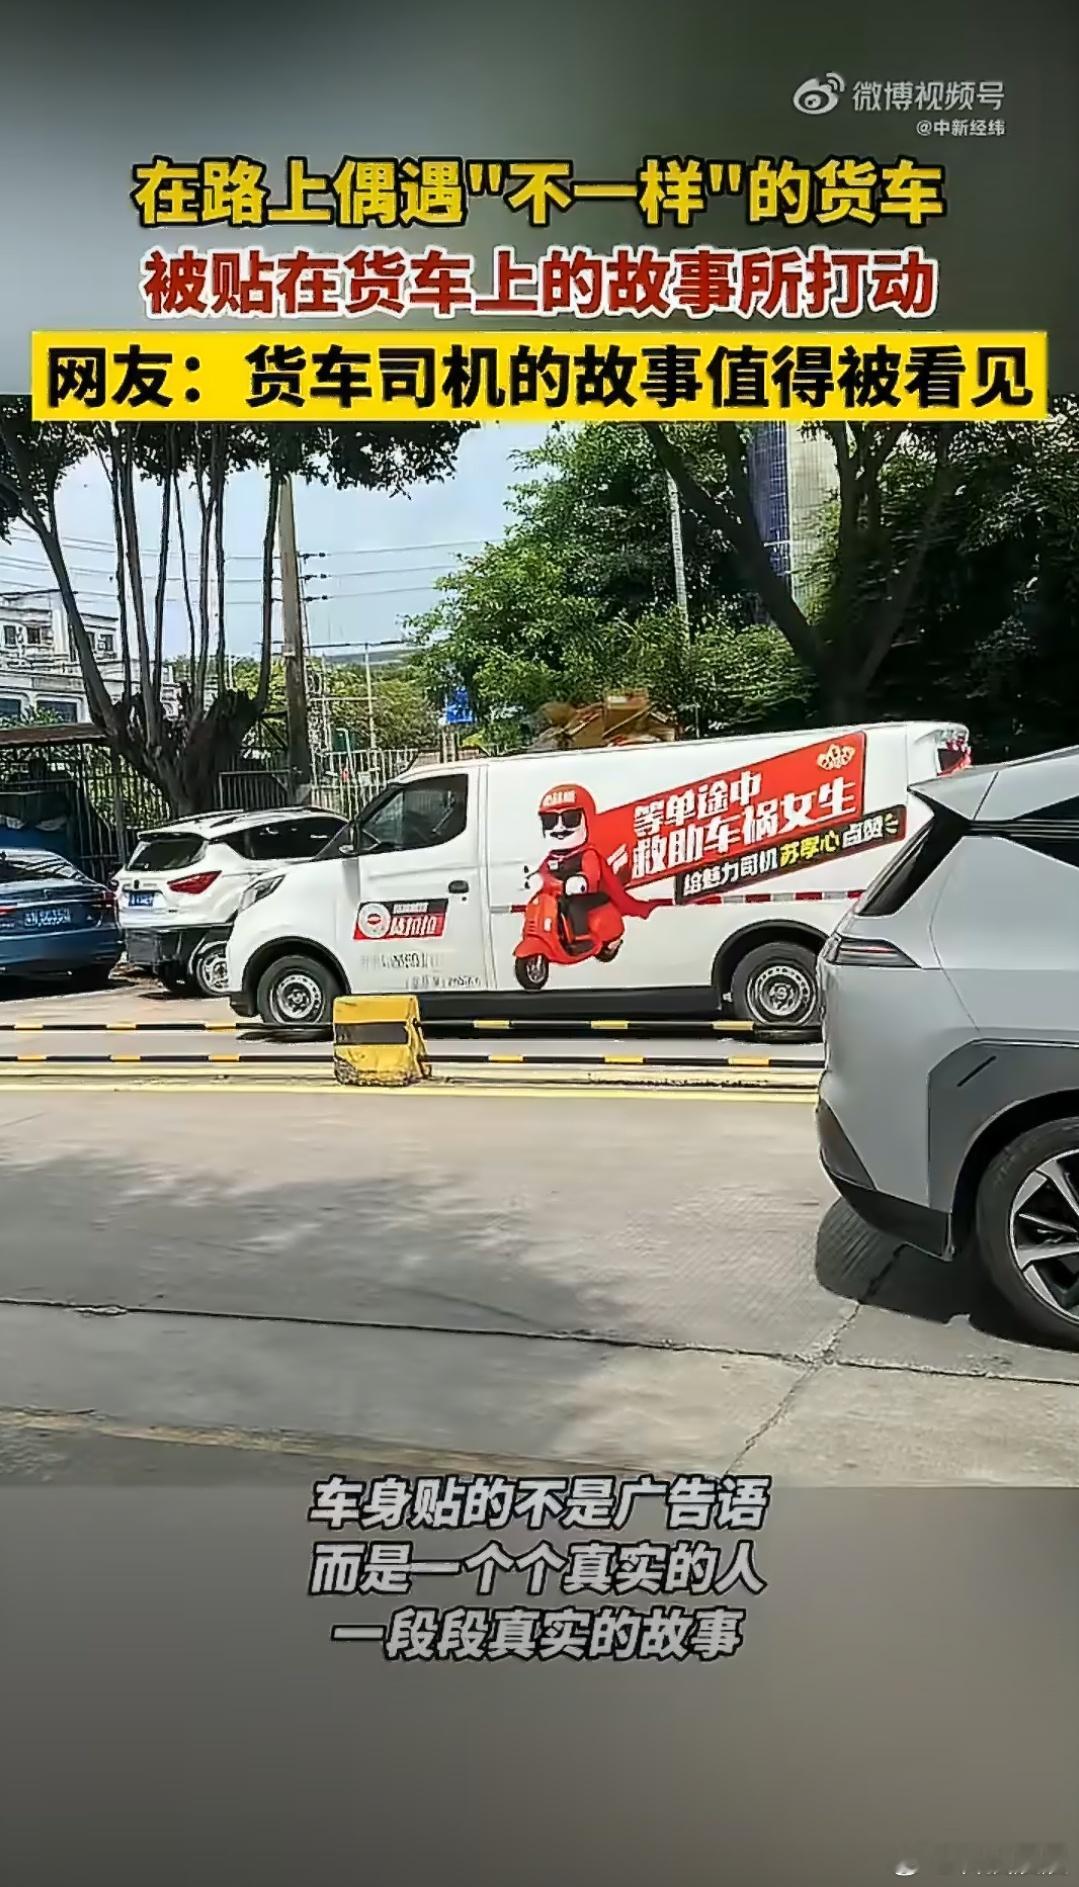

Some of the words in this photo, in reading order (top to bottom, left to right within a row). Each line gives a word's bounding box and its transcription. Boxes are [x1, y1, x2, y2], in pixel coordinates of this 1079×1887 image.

[631, 776, 857, 880] 救助车祸女生
[633, 770, 762, 838] 等单途中
